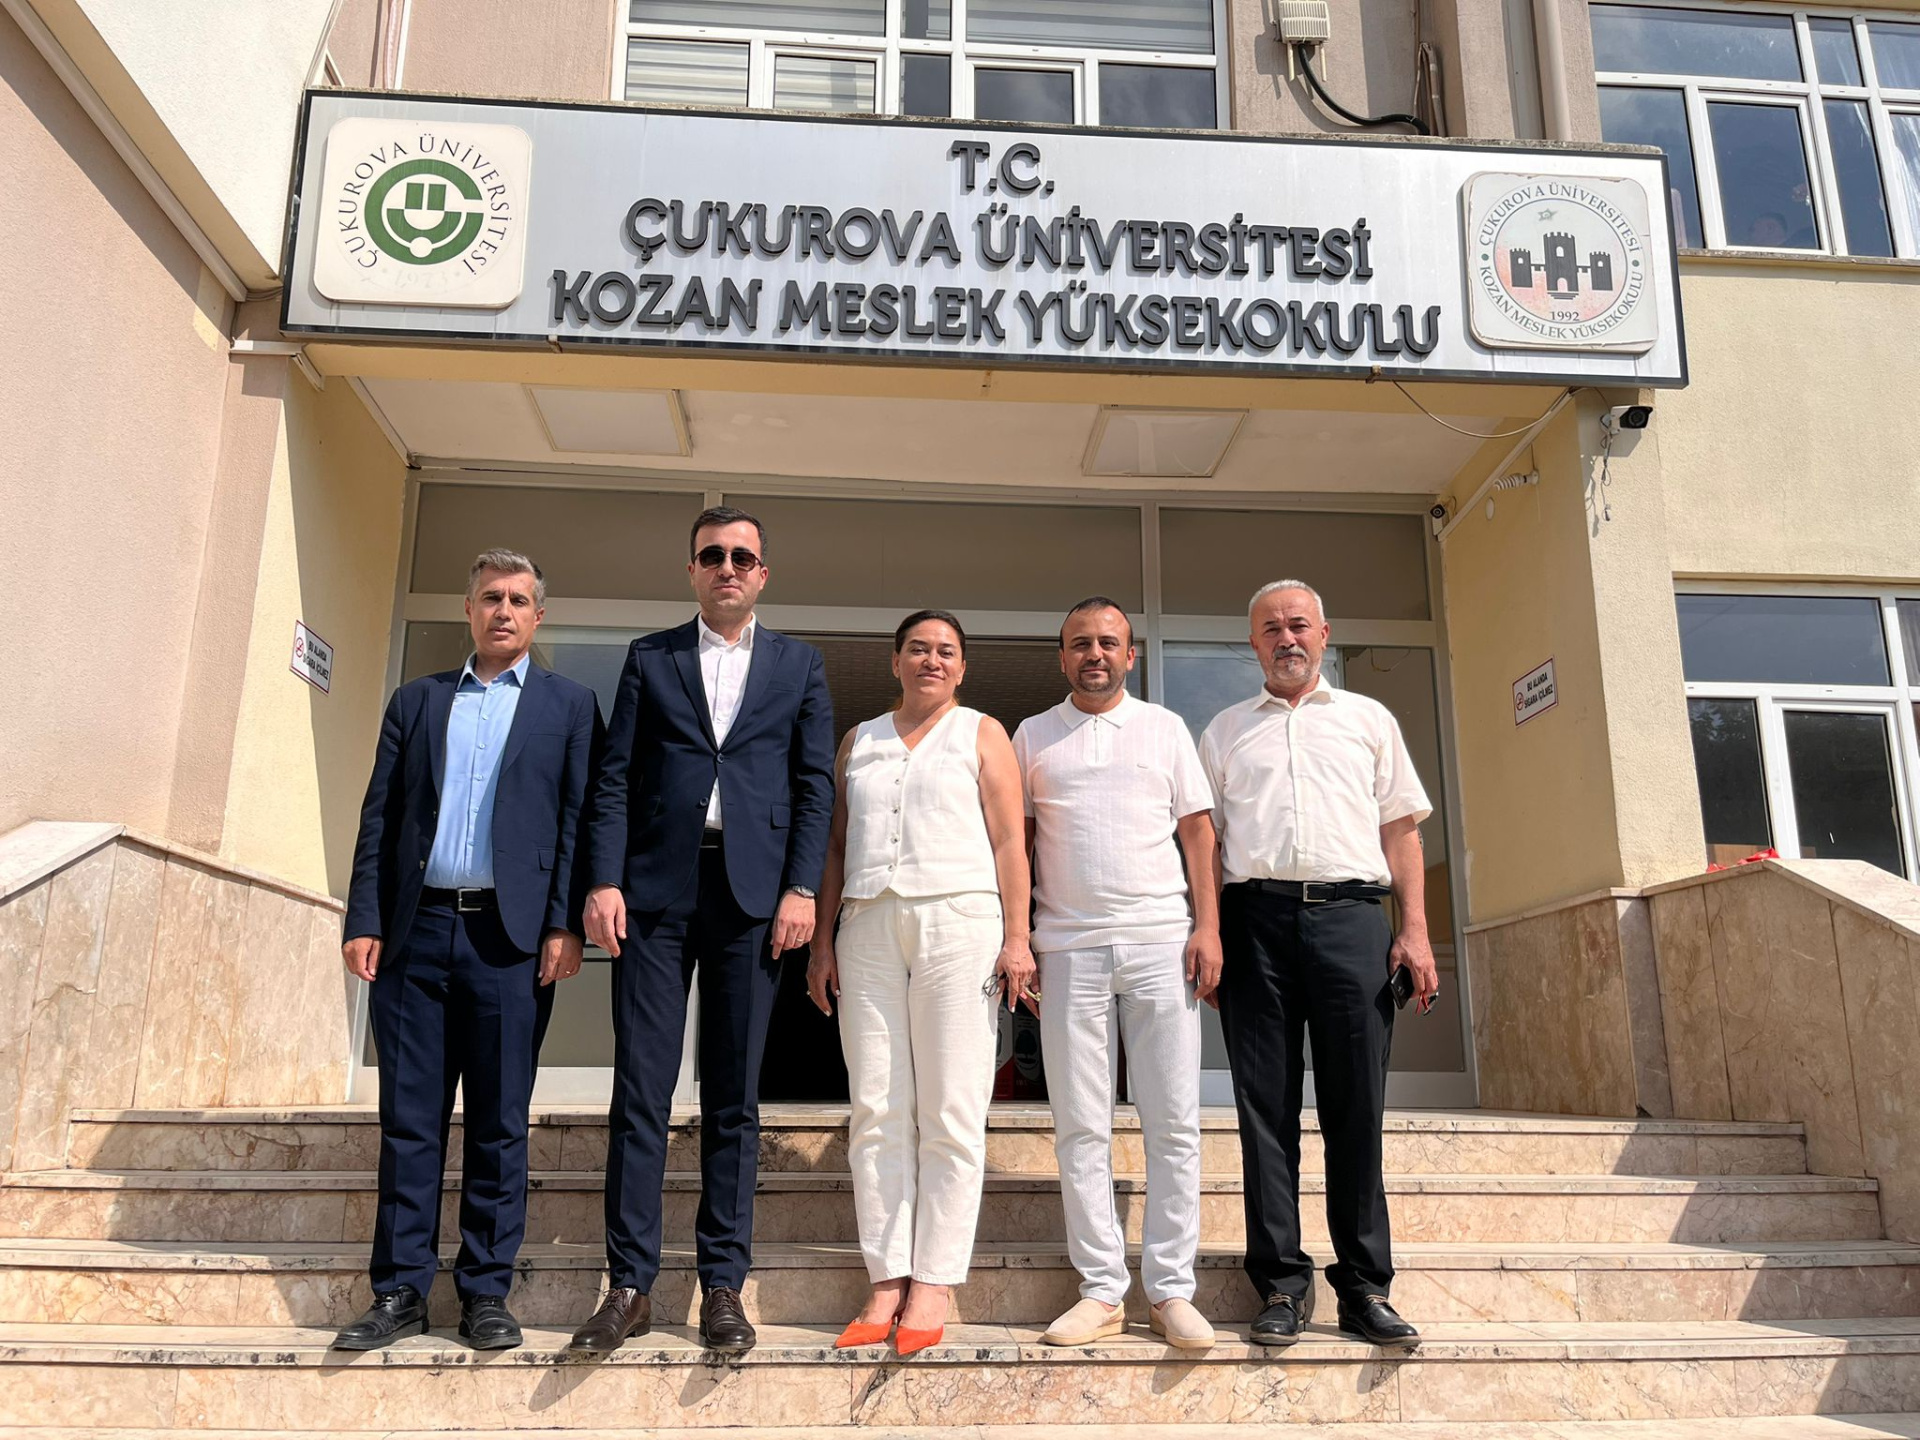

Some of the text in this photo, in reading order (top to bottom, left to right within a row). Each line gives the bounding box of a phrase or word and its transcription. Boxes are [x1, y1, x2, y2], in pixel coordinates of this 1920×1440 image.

[951, 140, 1054, 193] T.C.
[338, 133, 512, 275] ÇUKUROVA ÜNİVERSİTESİ
[625, 198, 1373, 277] ÇUKUROVA ÜNİVERSİTESİ
[1479, 182, 1643, 253] ÇUKUROVA ÜNİVERSİTESİ
[553, 269, 1441, 355] KOZAN MESLEK YÜKSEKOKULU
[1480, 265, 1643, 339] KOZAN MESLEK YÜKSEKOKULU
[1550, 311, 1580, 322] 1992
